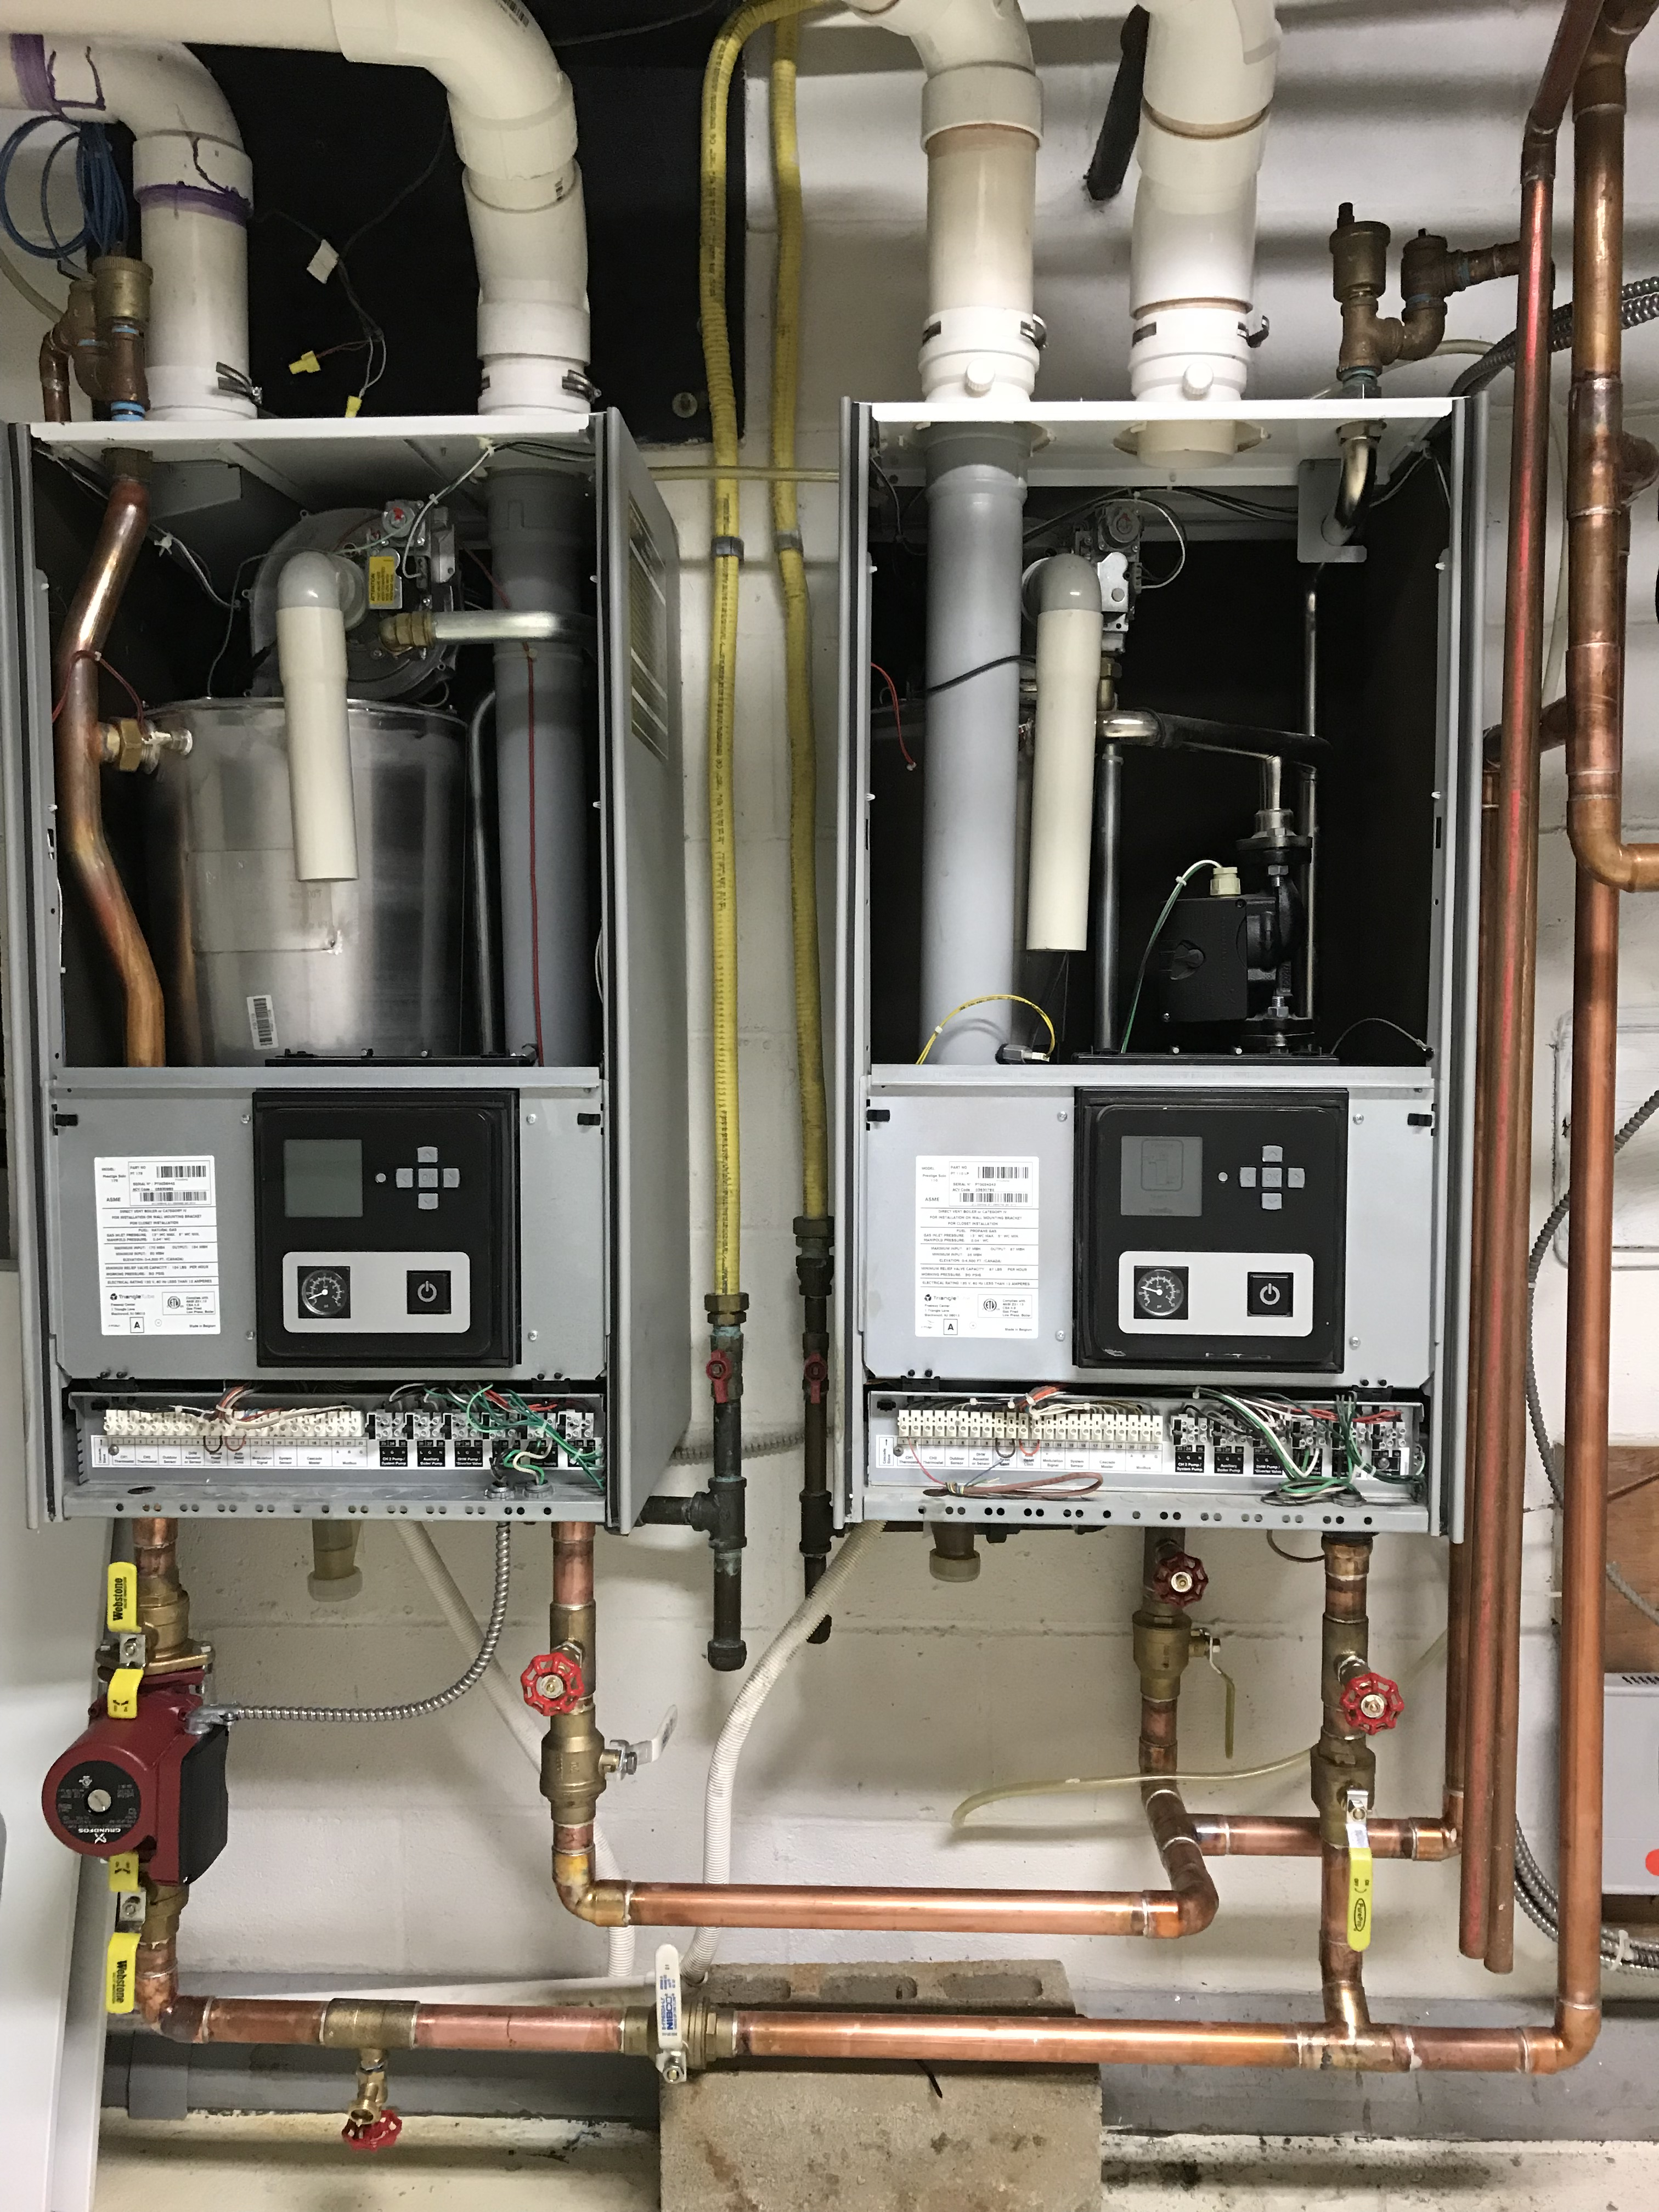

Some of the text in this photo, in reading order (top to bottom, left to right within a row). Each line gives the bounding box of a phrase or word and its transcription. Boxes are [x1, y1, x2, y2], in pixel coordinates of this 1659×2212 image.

[421, 1173, 435, 1182] OK
[1265, 1173, 1279, 1182] OK
[112, 1577, 123, 1621] Webstone
[116, 1960, 127, 2004] Webstone
